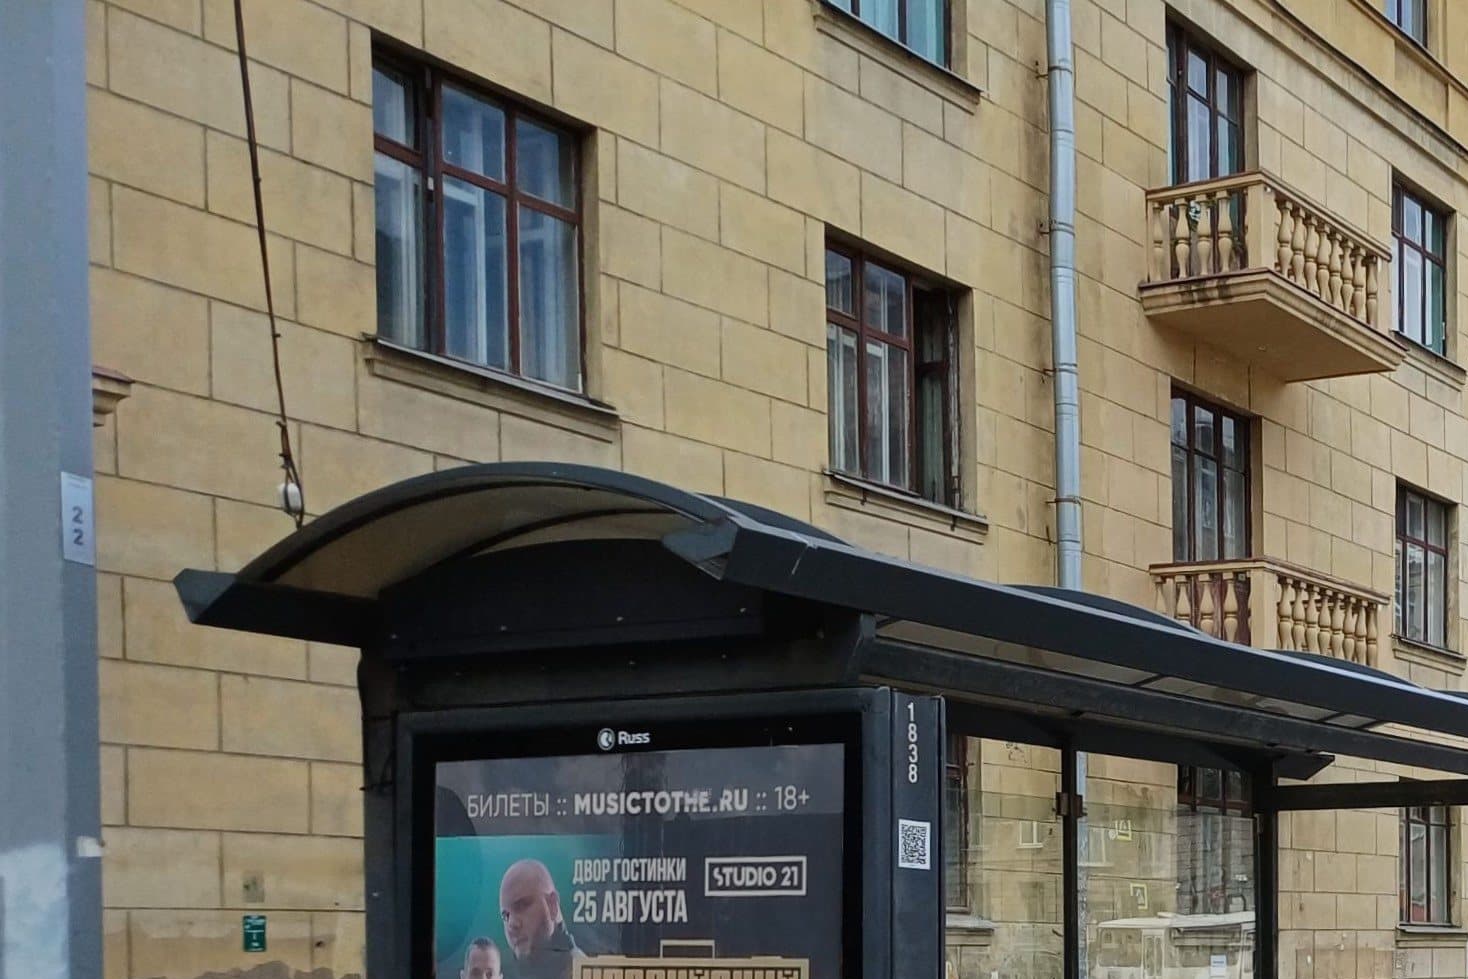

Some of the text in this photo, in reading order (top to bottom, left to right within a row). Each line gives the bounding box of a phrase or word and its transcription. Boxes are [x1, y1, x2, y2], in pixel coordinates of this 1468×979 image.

[618, 731, 651, 745] Russ
[467, 793, 551, 819] БИЛЕТЫ
[573, 789, 749, 816] MUSICTOTHE.RU
[774, 785, 811, 811] 18+
[572, 857, 687, 886] ДВОР ГОСТИНКИ
[713, 864, 799, 889] STUDIO 21
[573, 889, 688, 924] 25 АВГУСТА
